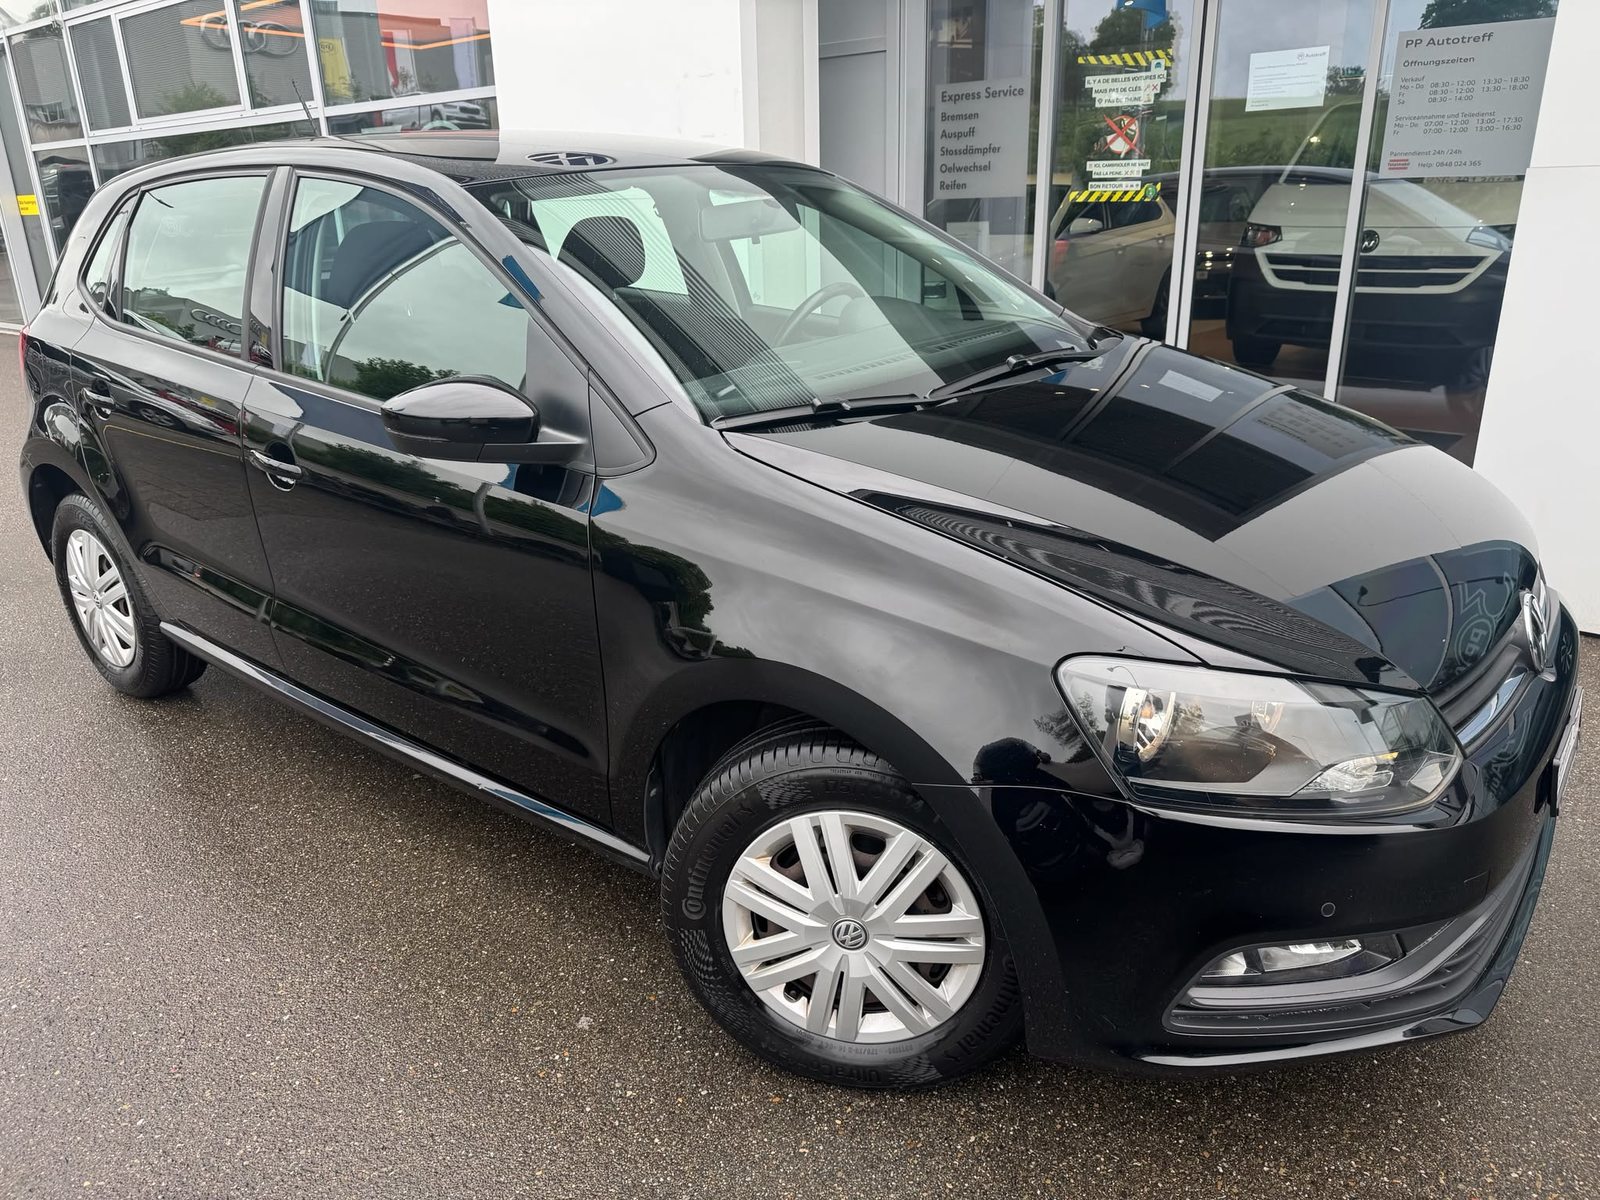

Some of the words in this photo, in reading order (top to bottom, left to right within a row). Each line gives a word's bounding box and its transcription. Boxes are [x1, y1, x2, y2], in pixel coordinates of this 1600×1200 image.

[1405, 38, 1423, 48] PP
[1426, 32, 1494, 47] Autotreff
[1403, 56, 1475, 67] Öffnungszeiten
[941, 91, 982, 105] Express
[985, 85, 1025, 99] Service
[940, 112, 979, 122] Bremsen
[1395, 114, 1446, 122] Serviceannahme
[940, 126, 976, 140] Auspuff
[940, 143, 1002, 157] Stossdämpfer
[940, 161, 991, 174] Oelwechsel
[1436, 160, 1452, 168] 0848
[940, 180, 967, 191] Reifen
